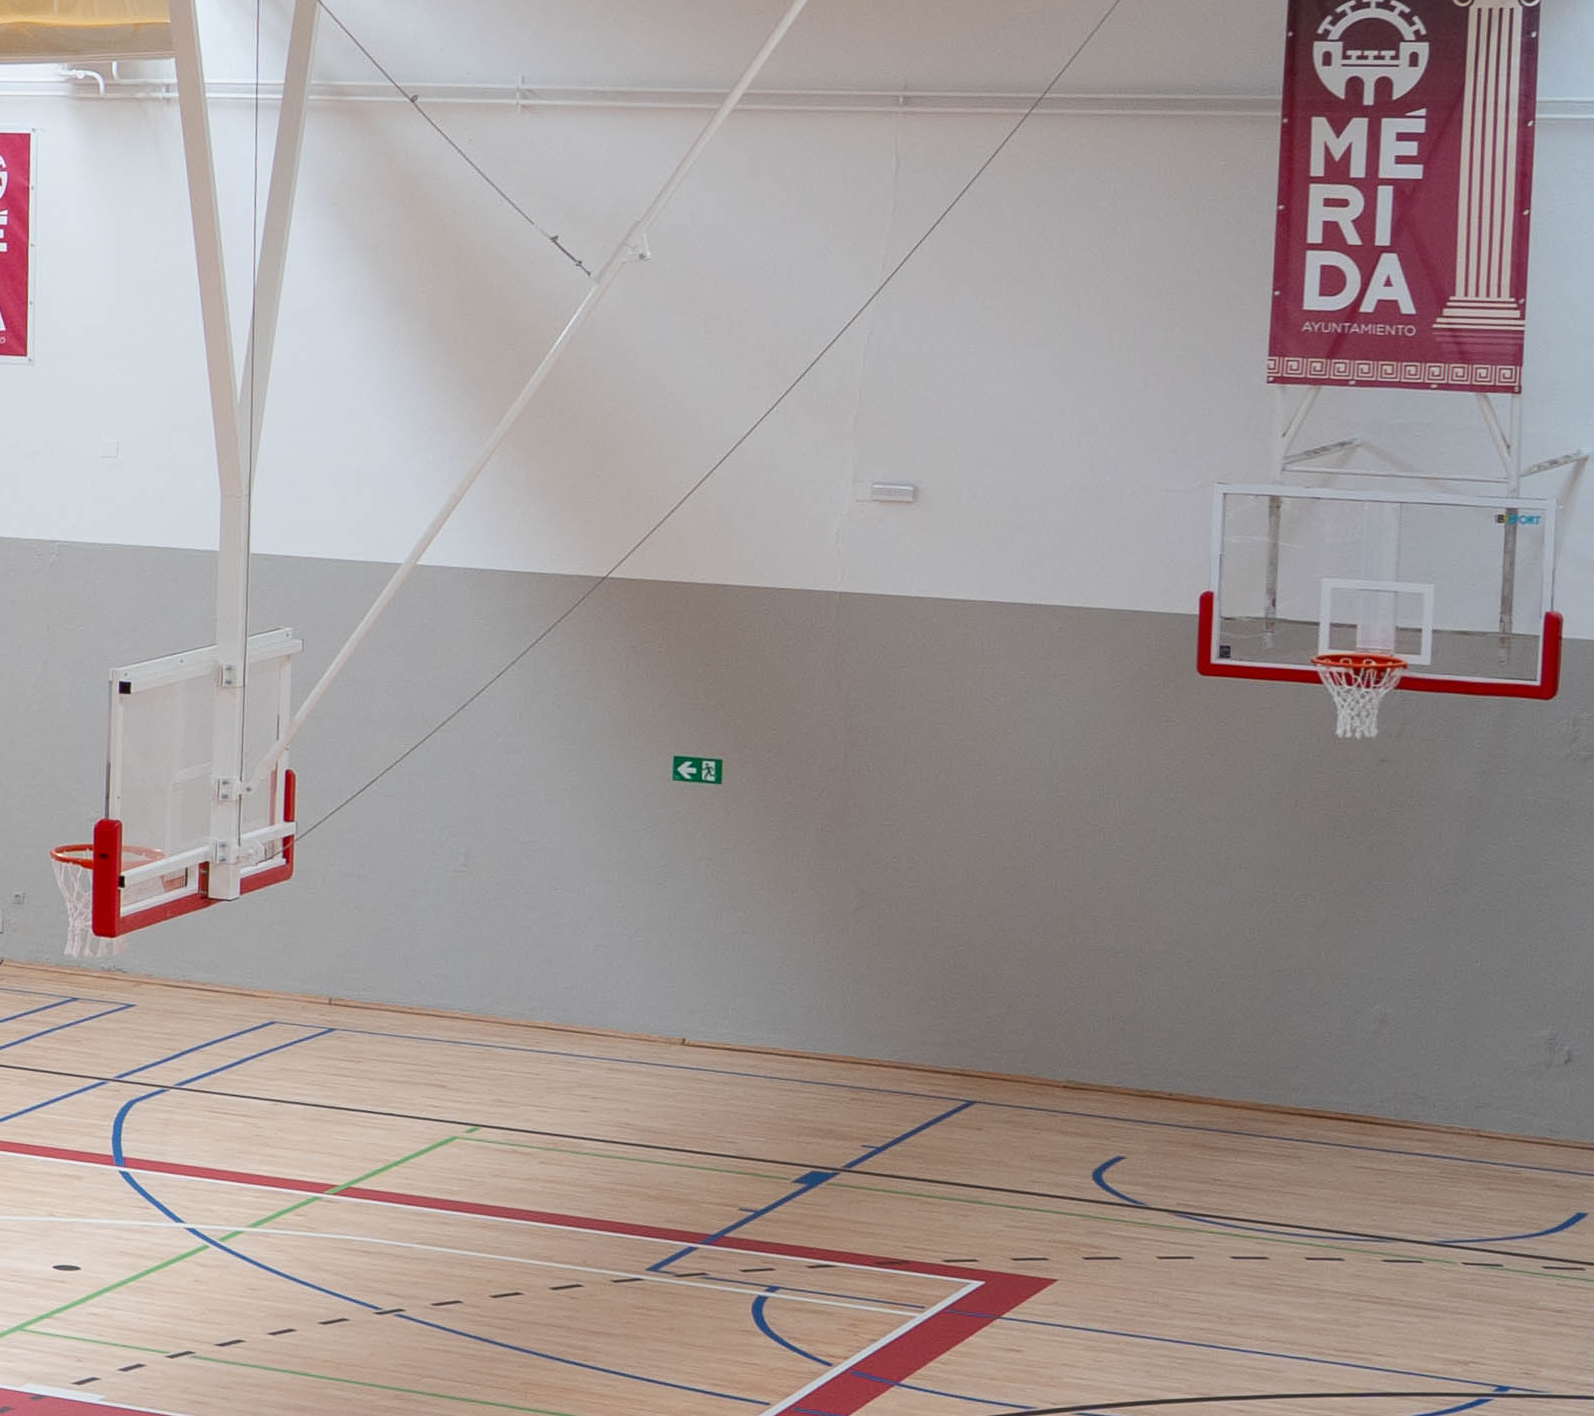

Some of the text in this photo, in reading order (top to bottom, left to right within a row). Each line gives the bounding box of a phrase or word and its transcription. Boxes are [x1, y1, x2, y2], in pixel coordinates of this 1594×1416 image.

[1309, 108, 1427, 180] MÉ
[1306, 183, 1394, 246] RI
[1302, 250, 1417, 315] DA
[1301, 321, 1417, 337] AYUNTAMIENTO
